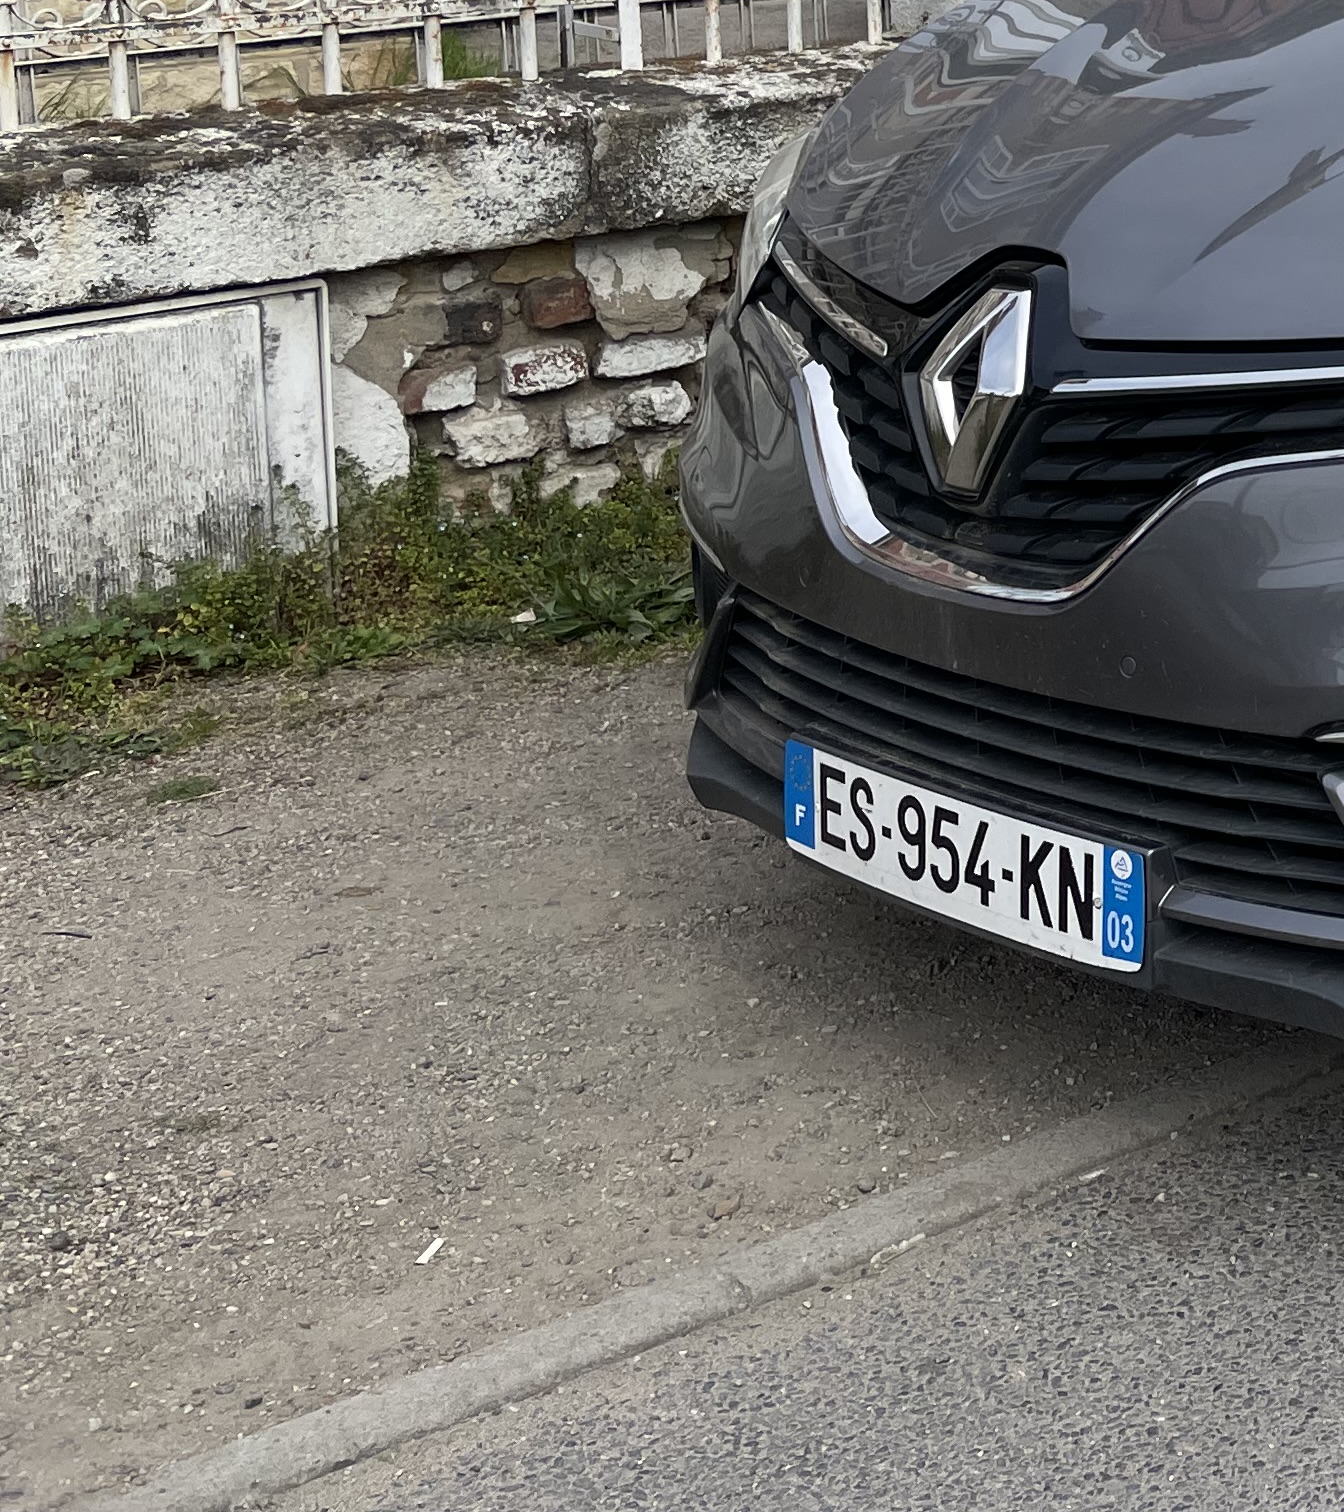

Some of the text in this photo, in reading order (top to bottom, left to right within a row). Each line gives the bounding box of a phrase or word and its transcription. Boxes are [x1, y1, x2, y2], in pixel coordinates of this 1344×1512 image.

[795, 804, 806, 827] F
[819, 762, 1095, 942] ES-954-KN
[1107, 910, 1134, 953] 03
